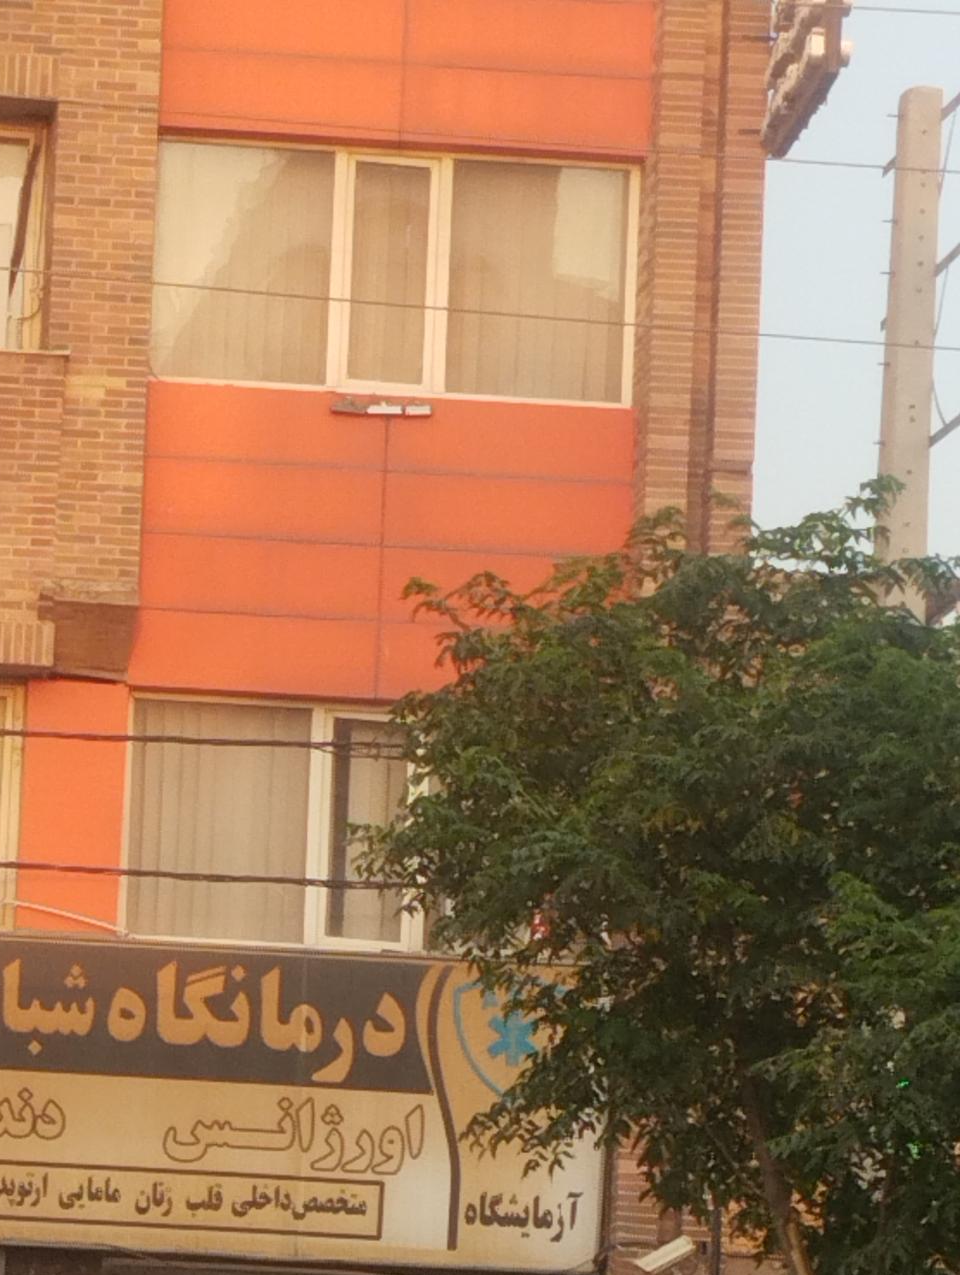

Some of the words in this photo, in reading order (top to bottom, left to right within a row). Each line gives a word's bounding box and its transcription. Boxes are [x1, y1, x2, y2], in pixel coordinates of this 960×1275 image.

[107, 960, 406, 1083] درمانگاه
[162, 1096, 425, 1175] اورژانس
[58, 1175, 122, 1211] مامایی
[134, 1181, 173, 1218] زنان
[185, 1183, 224, 1218] قلب
[231, 1183, 293, 1218] داخلی
[291, 1188, 368, 1221] متخصص
[464, 1191, 584, 1243] آزمایشگاه
